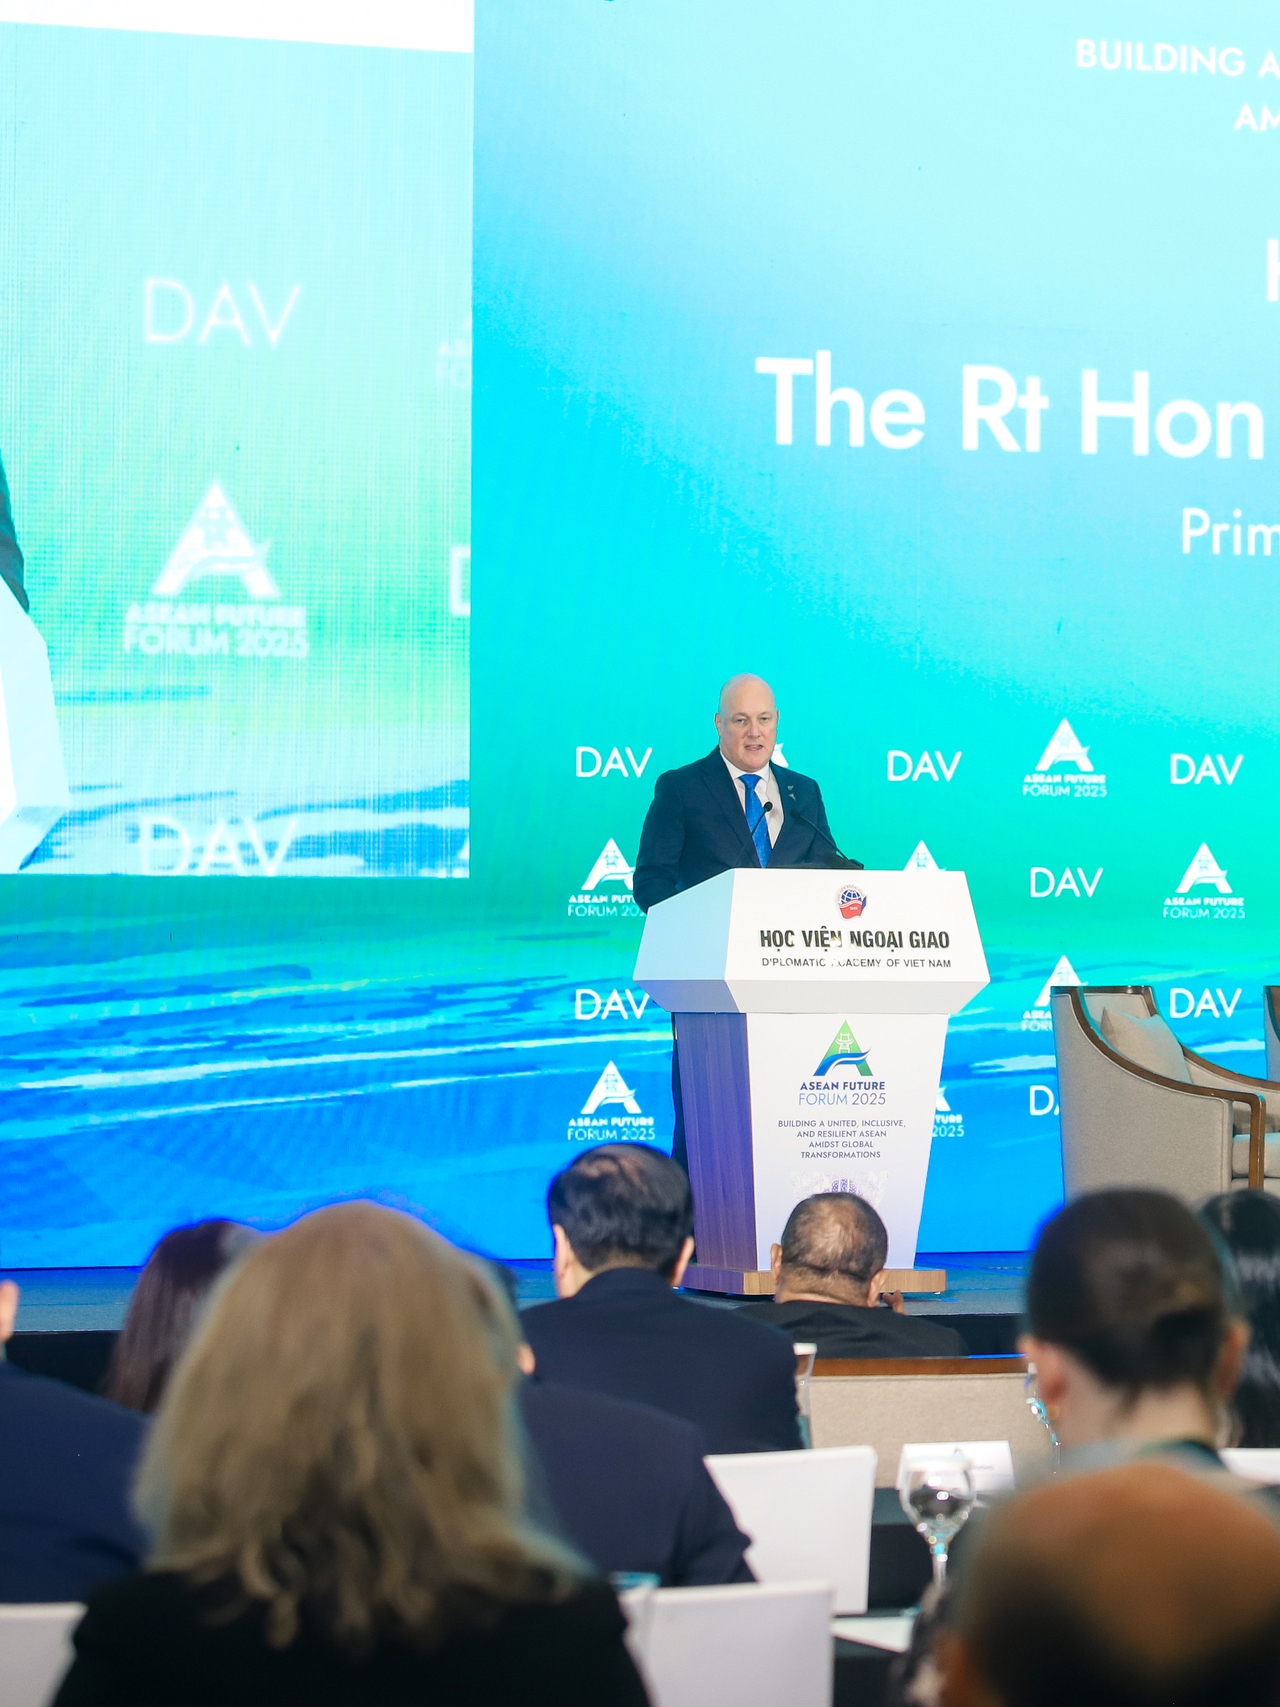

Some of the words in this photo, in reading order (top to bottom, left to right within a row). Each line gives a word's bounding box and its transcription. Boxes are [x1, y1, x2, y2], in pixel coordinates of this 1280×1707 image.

[1076, 38, 1246, 77] BUILDING
[143, 275, 303, 349] DAV
[755, 348, 926, 450] The
[962, 363, 1050, 452] Rt
[1081, 368, 1265, 459] Hon
[125, 625, 228, 655] FORUM
[576, 745, 653, 778] DAV
[887, 750, 962, 782] DAV
[1170, 753, 1244, 786] DAV
[139, 814, 298, 876] DAV
[1030, 866, 1104, 898] DAV
[567, 905, 618, 917] FORUM
[760, 929, 795, 952] HỌC
[801, 925, 843, 952] VIỆN
[849, 929, 904, 952] NGOẠI
[909, 930, 950, 949] GIAO
[886, 958, 901, 967] OF
[903, 959, 926, 968] VIET
[928, 959, 952, 968] NAM
[574, 988, 650, 1020] DAV
[1170, 987, 1243, 1019] DAV
[798, 1093, 848, 1106] FORUM
[851, 1093, 887, 1106] 2025
[800, 1081, 839, 1091] ASEAN
[842, 1081, 886, 1091] FUTURE
[567, 1128, 618, 1141] FORUM
[621, 1128, 656, 1141] 2025
[778, 1119, 817, 1128] BUILDING
[819, 1120, 826, 1128] A
[827, 1119, 860, 1129] UNITED,
[861, 1119, 907, 1129] INCLUSIVE,
[796, 1130, 816, 1138] AND
[817, 1130, 858, 1138] RESILIENT
[859, 1130, 887, 1138] ASEAN
[800, 1151, 882, 1159] TRANSFORMATIONS
[808, 1140, 840, 1149] AMIDST
[841, 1140, 875, 1149] GLOBAL
